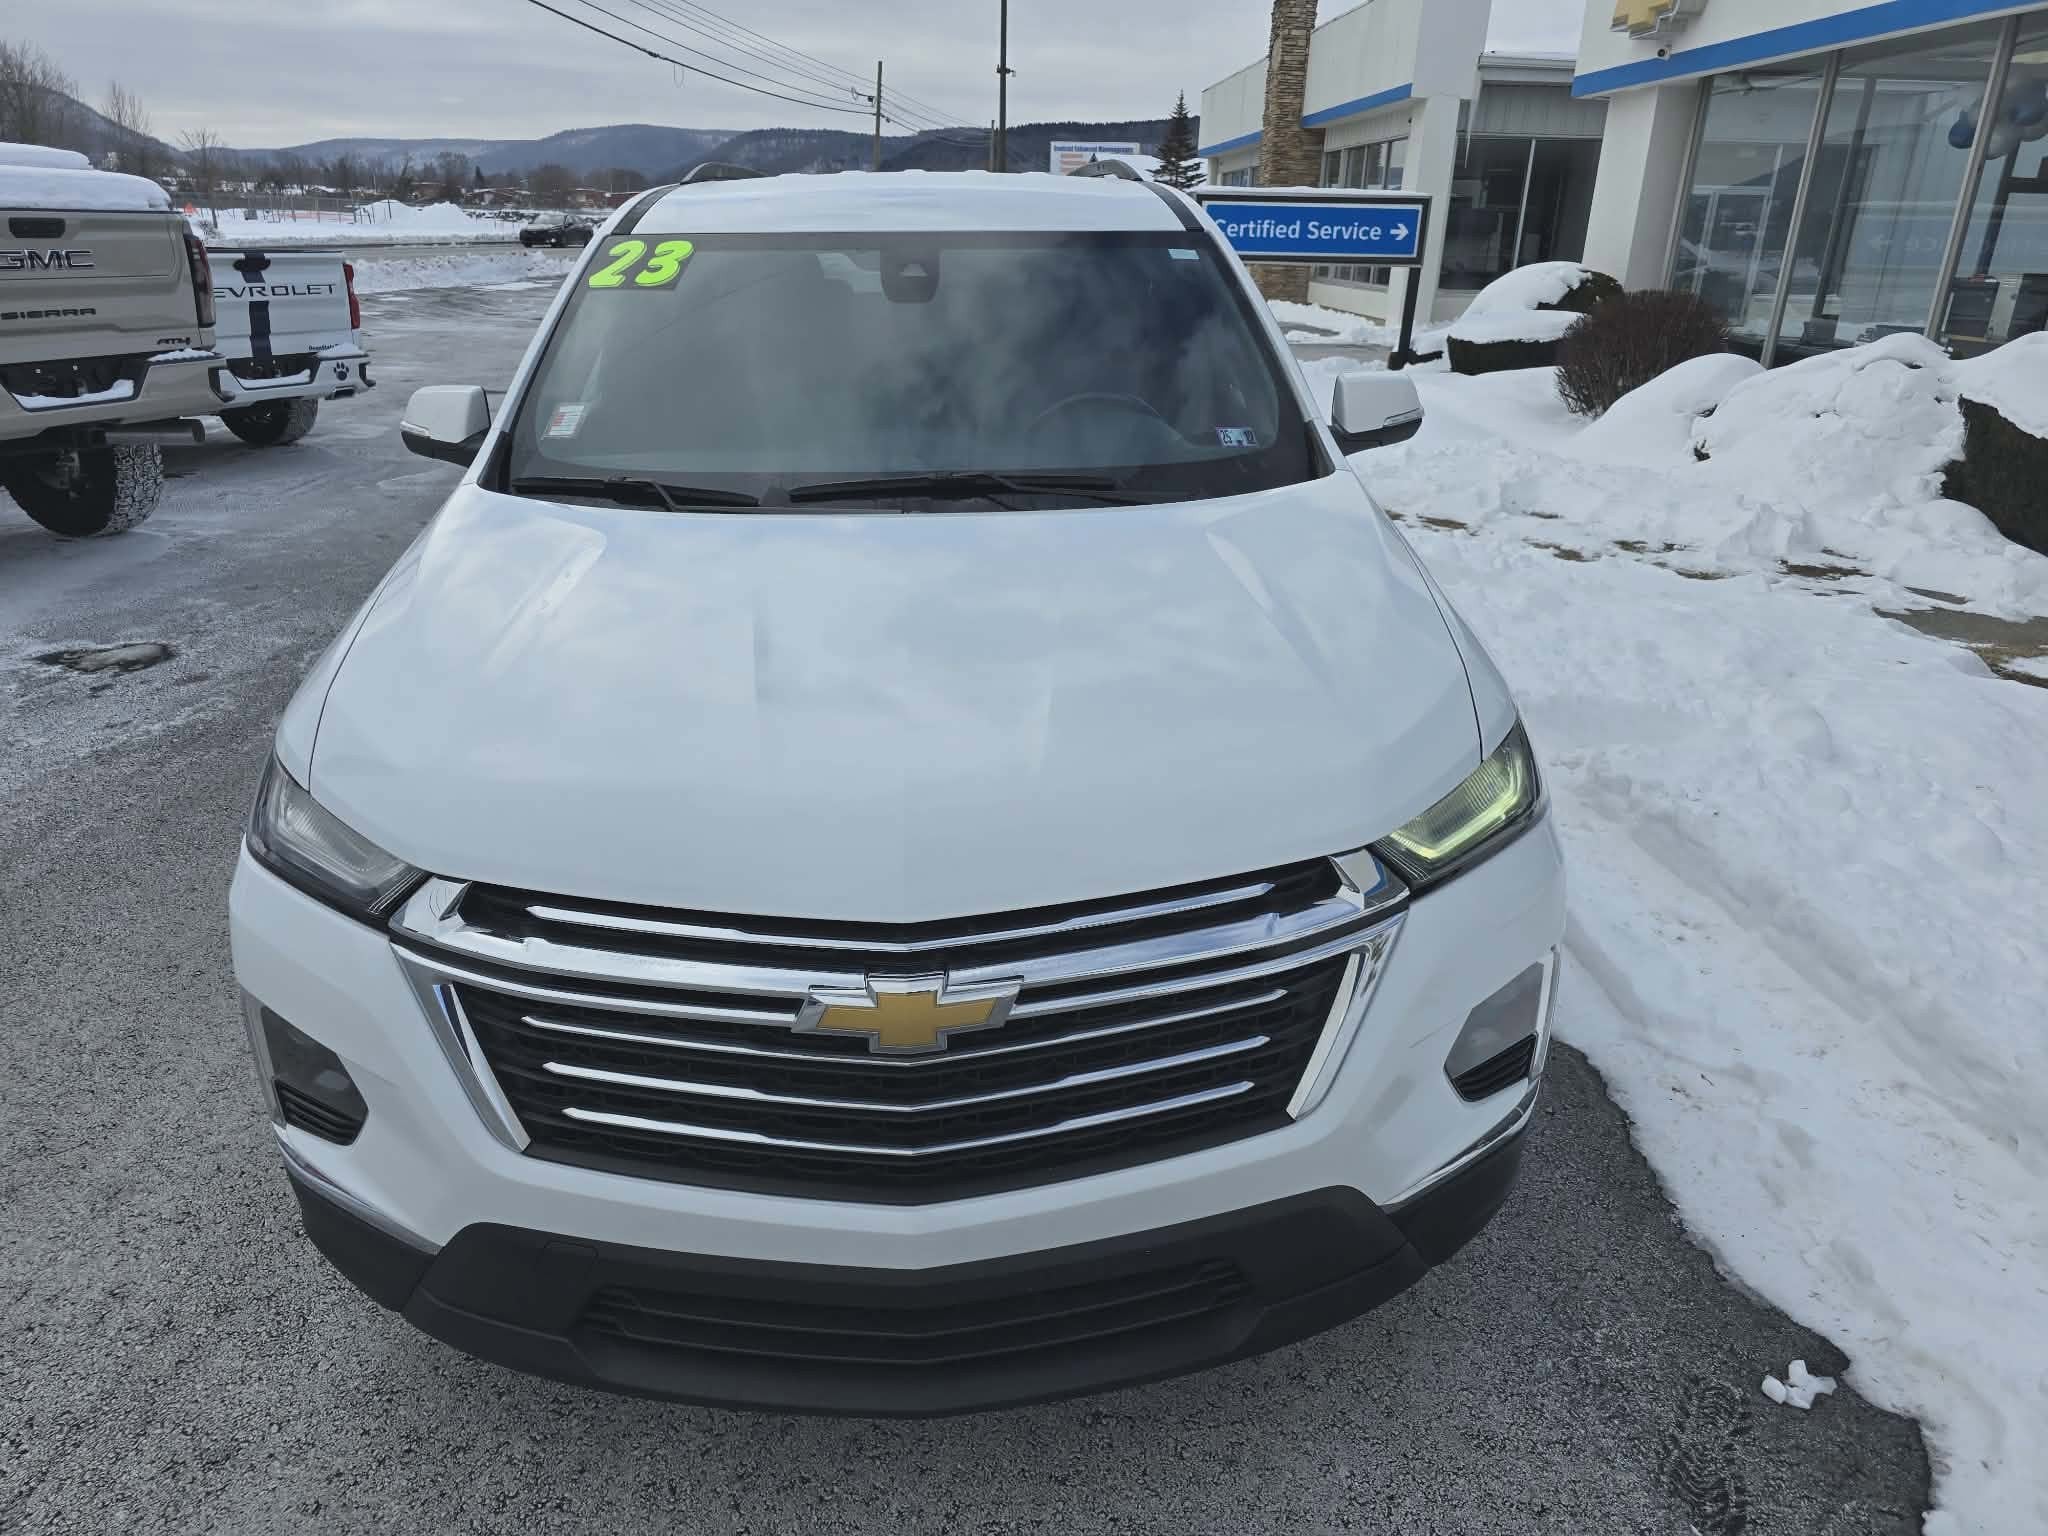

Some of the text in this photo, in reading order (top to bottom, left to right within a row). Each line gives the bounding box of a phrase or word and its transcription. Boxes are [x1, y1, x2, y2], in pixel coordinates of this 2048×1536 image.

[1307, 221, 1382, 241] Service
[0, 249, 96, 271] GMC
[589, 240, 695, 288] 23
[213, 283, 336, 298] EVROLET
[1, 308, 96, 320] SIERRA
